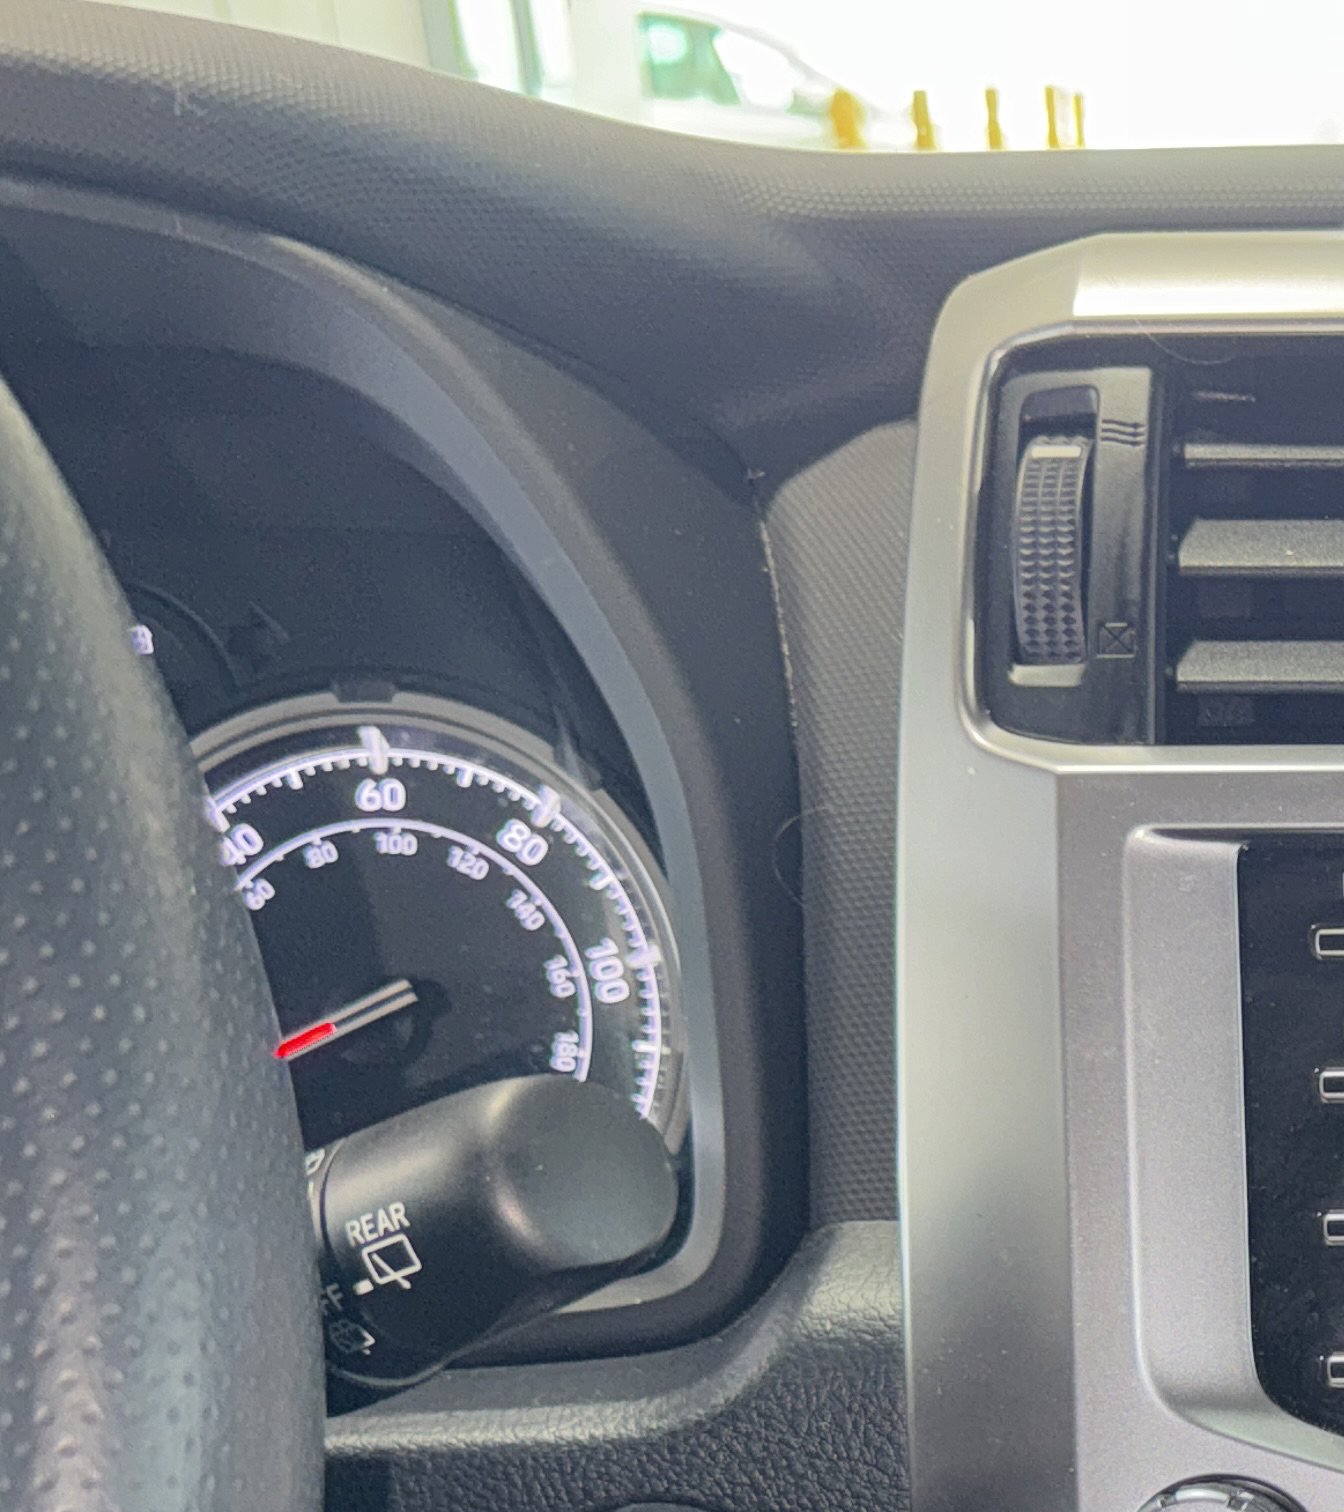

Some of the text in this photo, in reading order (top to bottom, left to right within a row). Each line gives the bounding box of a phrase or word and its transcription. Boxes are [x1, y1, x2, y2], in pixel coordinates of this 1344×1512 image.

[355, 778, 407, 812] 60
[222, 823, 264, 867] 40
[303, 839, 339, 869] 80
[374, 829, 418, 857] 100
[447, 845, 489, 880] 120
[497, 818, 549, 866] 80
[244, 878, 276, 911] 60
[506, 888, 546, 931] 140
[544, 953, 575, 999] 160
[585, 937, 630, 1004] 100
[549, 1031, 580, 1073] 180
[345, 1201, 411, 1247] REAR
